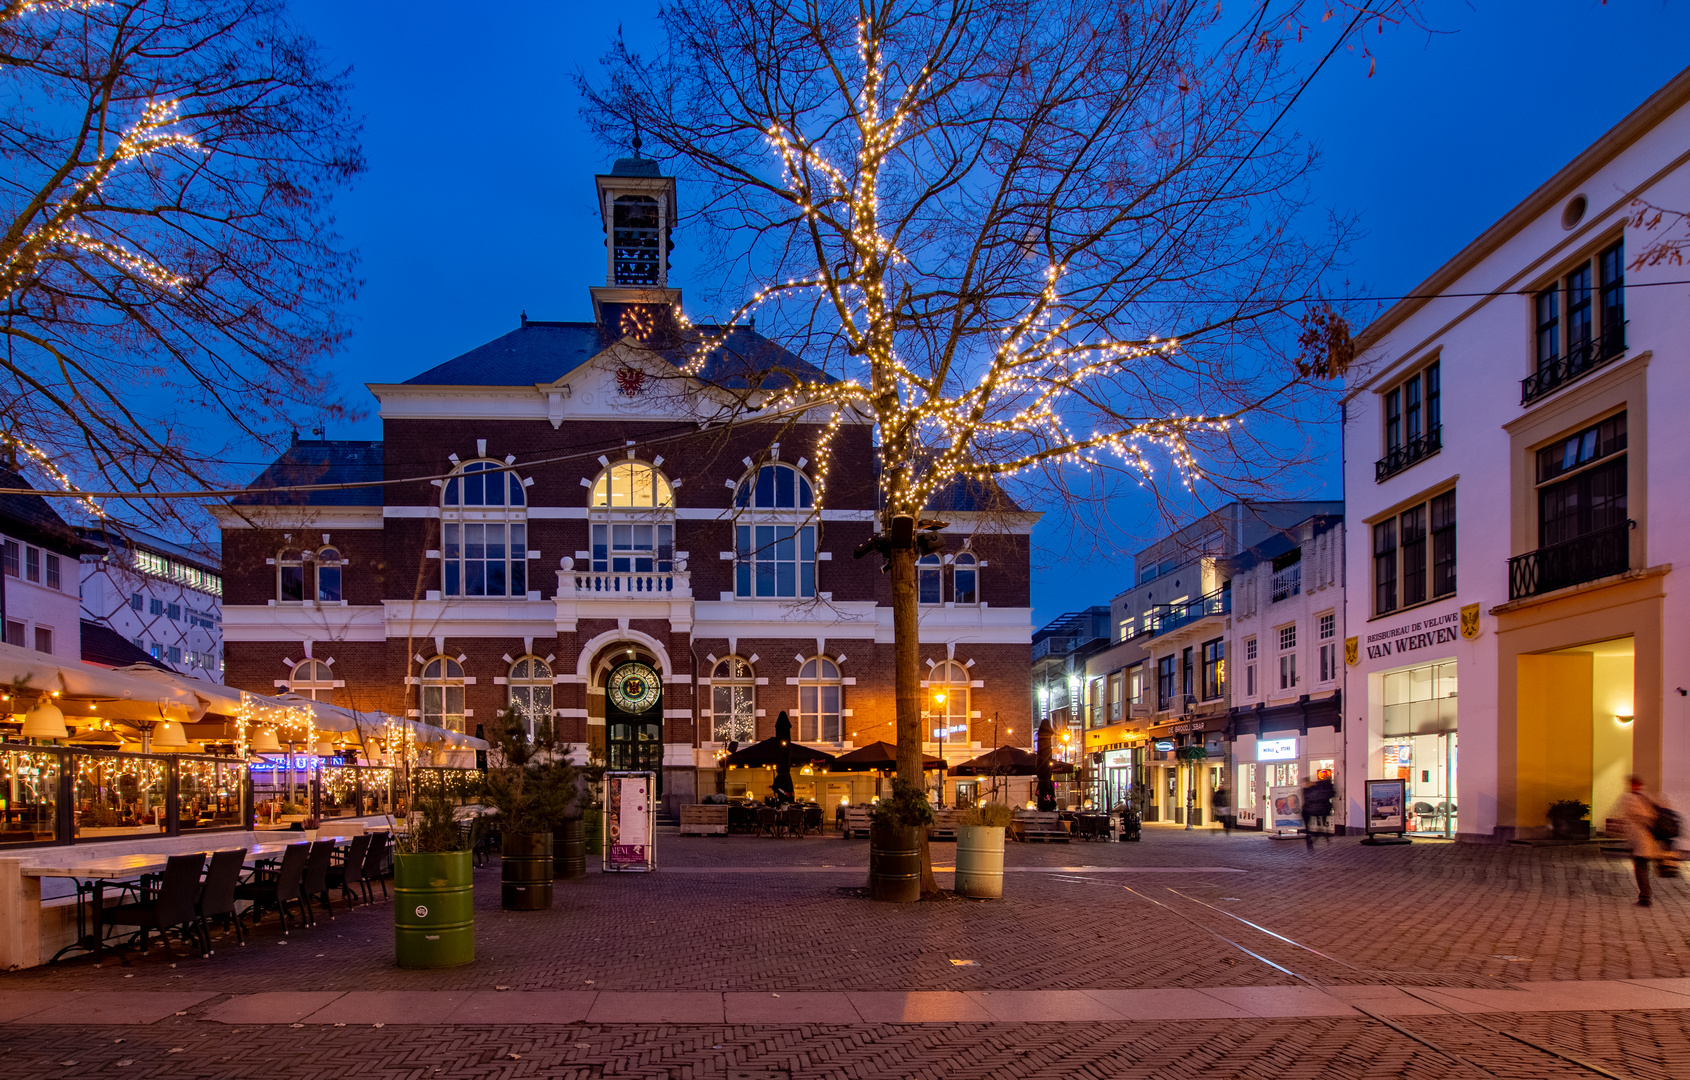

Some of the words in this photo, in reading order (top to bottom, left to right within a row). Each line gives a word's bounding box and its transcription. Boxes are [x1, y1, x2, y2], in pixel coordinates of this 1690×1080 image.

[1367, 625, 1410, 643] REISBUREAU
[1411, 622, 1422, 632] DE
[1423, 612, 1458, 629] VELUWE
[1366, 641, 1392, 660] VAN
[1394, 625, 1459, 654] WERVEN
[1168, 726, 1175, 734] DE
[1174, 722, 1206, 732] BROODJSBAR
[611, 846, 630, 855] MENU
